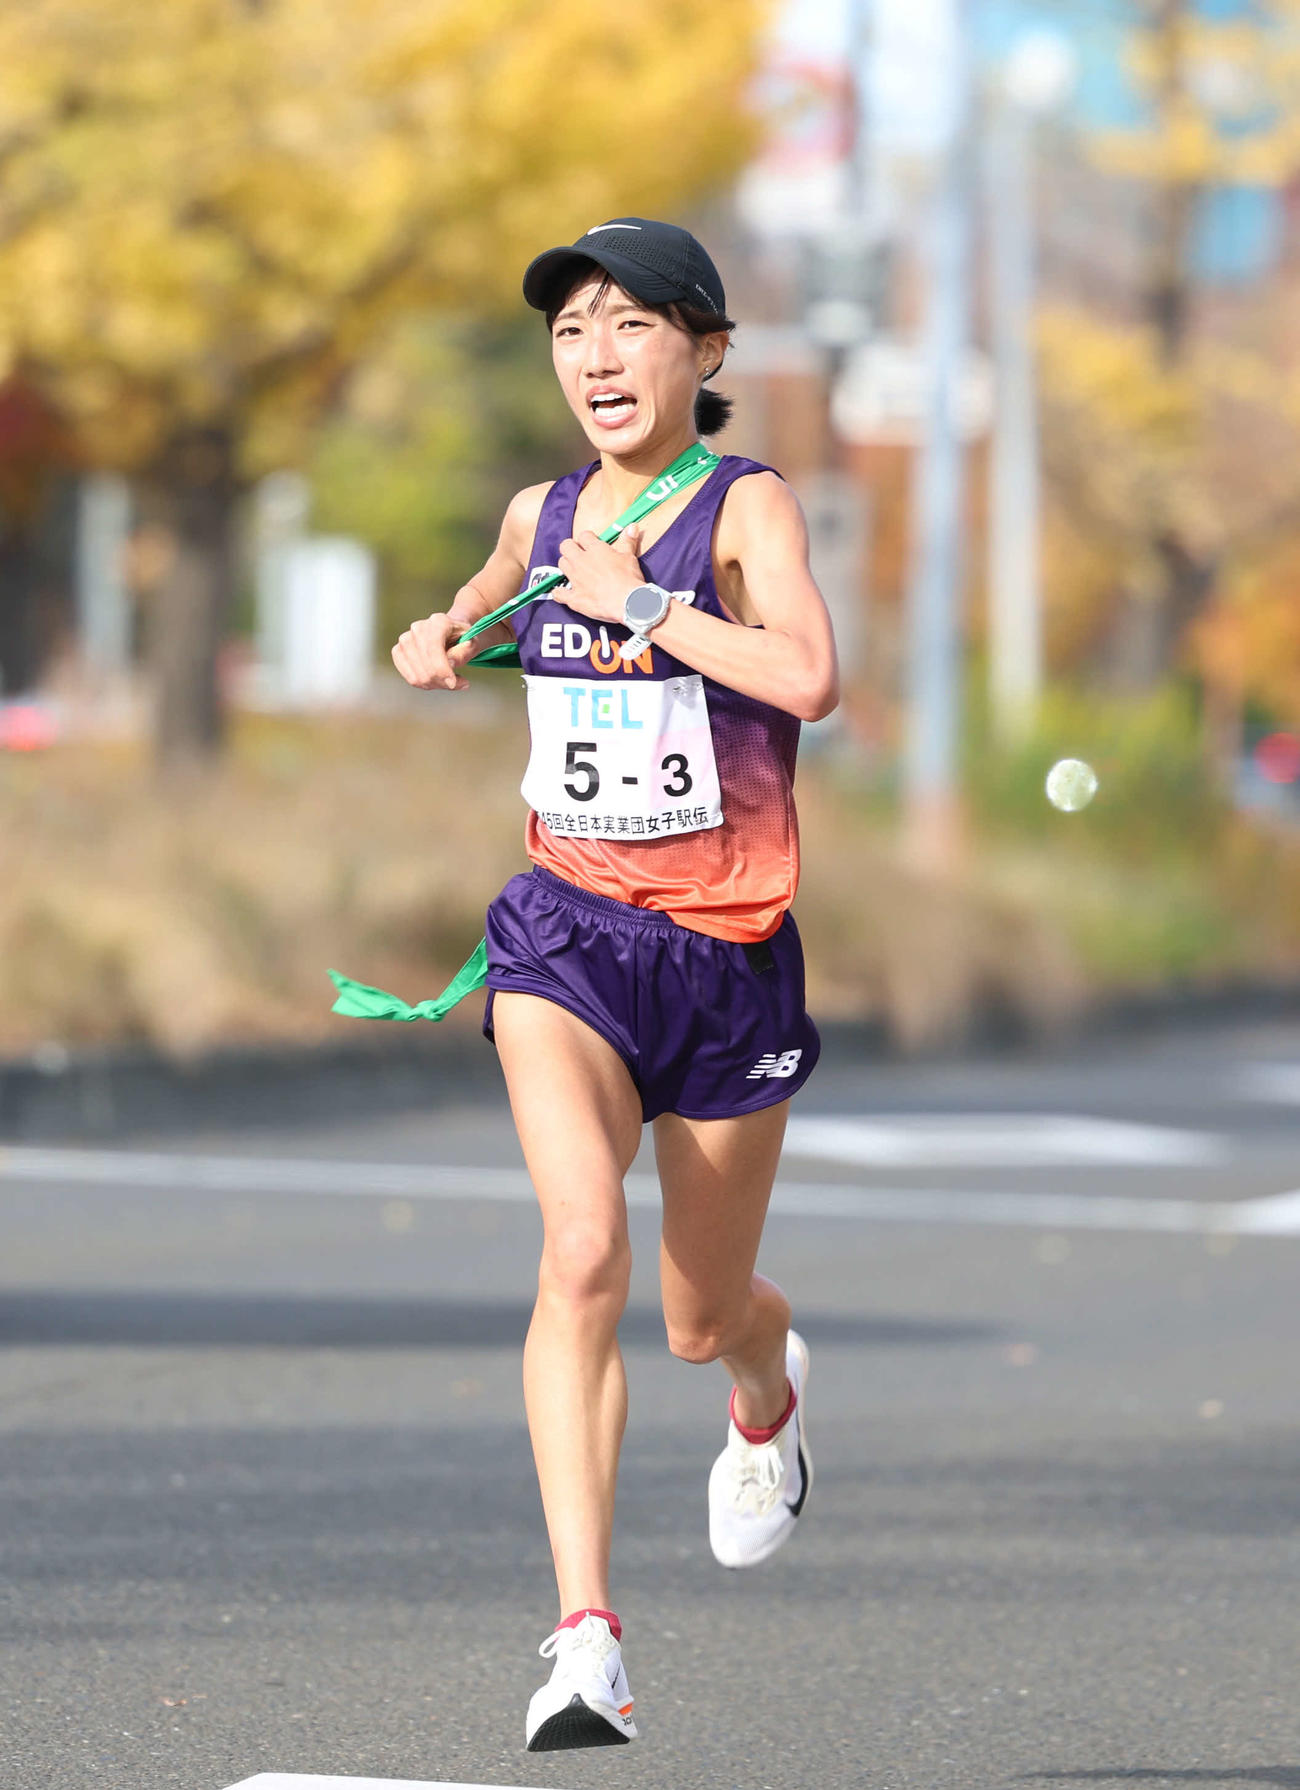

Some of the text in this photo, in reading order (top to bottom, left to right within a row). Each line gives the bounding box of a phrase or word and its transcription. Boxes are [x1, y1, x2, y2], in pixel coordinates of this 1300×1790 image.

[563, 687, 644, 729] TEL
[537, 807, 709, 834] 45回全日本実業団女子駅伝
